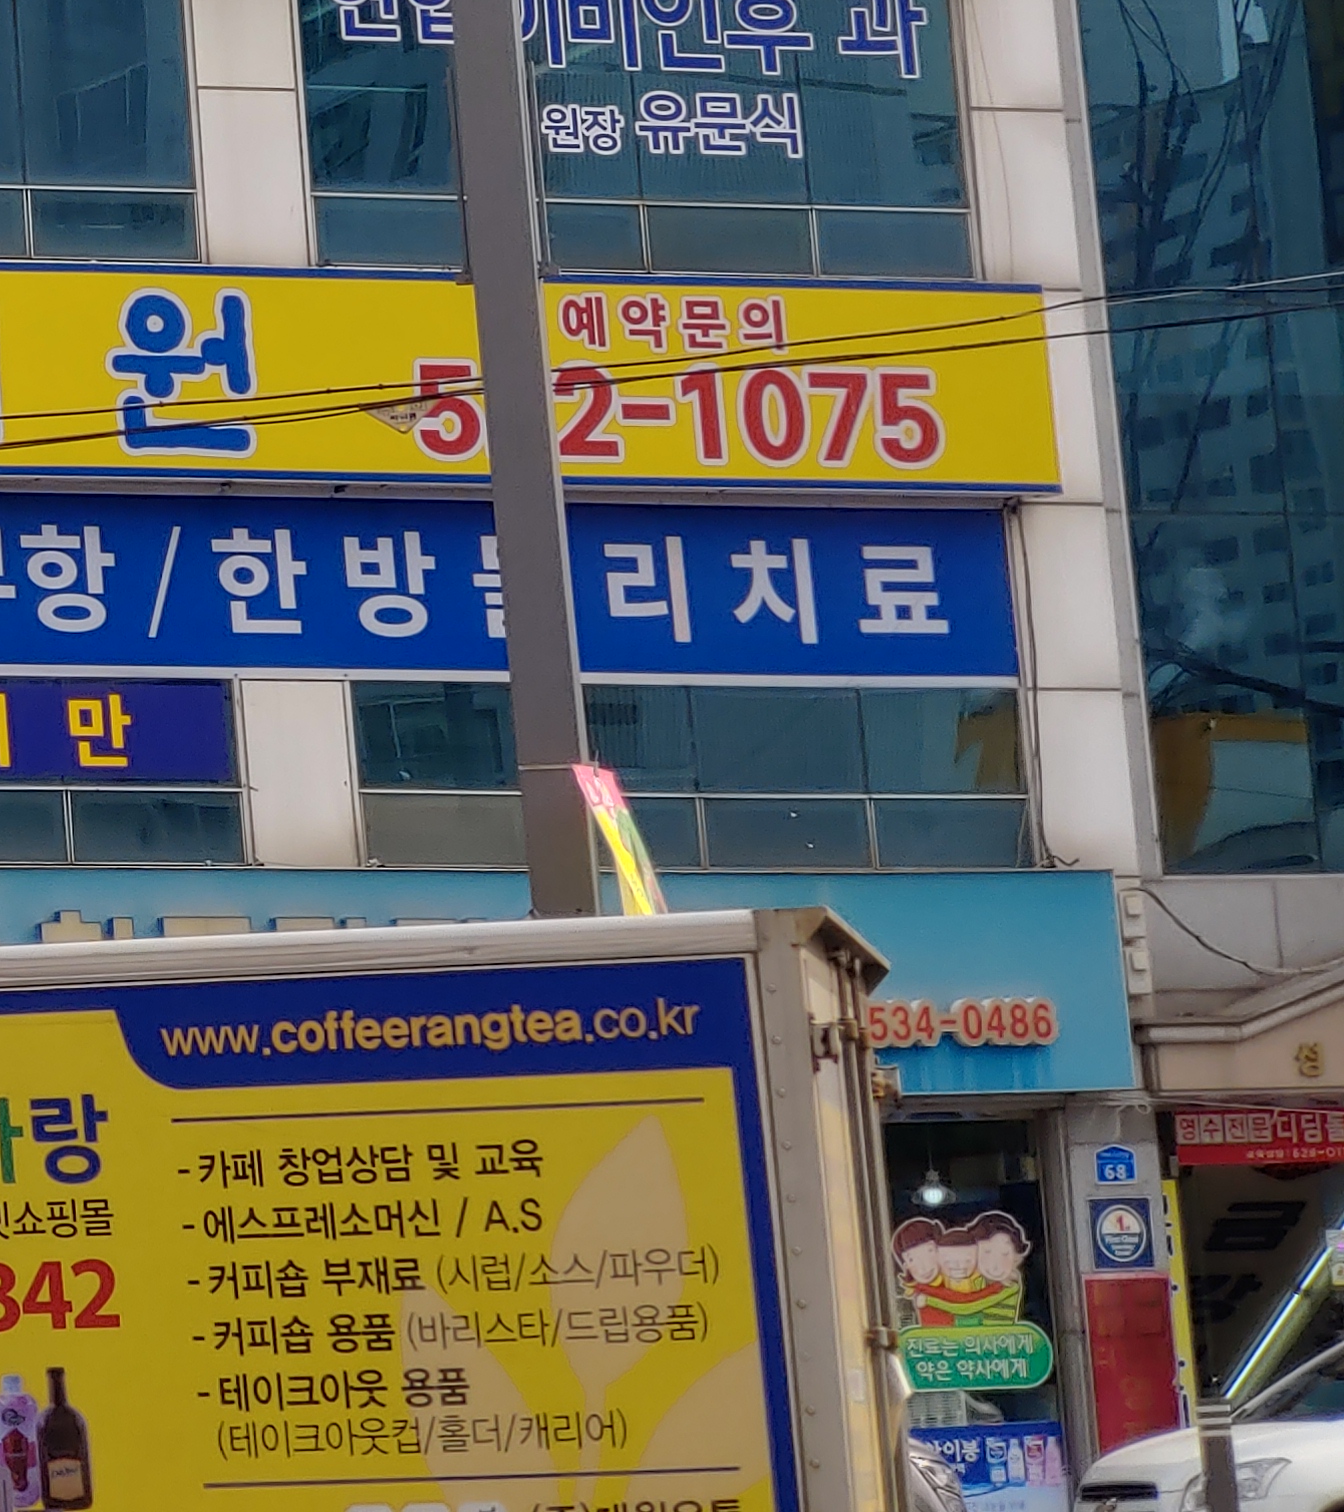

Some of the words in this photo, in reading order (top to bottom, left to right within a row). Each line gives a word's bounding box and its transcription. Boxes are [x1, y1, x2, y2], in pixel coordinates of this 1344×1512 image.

[541, 103, 624, 156] 원장
[635, 90, 803, 158] 유문식
[559, 292, 788, 354] 예약문의
[413, 357, 946, 470] 52-1075
[159, 997, 700, 1058] www.coffeerangtea.co.kr
[868, 997, 1057, 1048] 534-0486
[277, 1145, 414, 1186] 창업상담
[428, 1142, 460, 1181] 및
[474, 1138, 544, 1178] 교육
[321, 1255, 427, 1296] 부재료
[325, 1313, 396, 1352] 용품
[906, 1337, 959, 1359] 진료는
[965, 1334, 1035, 1356] 의사에게
[400, 1366, 470, 1408] 용품
[915, 1359, 953, 1382] 약은
[957, 1358, 1029, 1380] 약사에게
